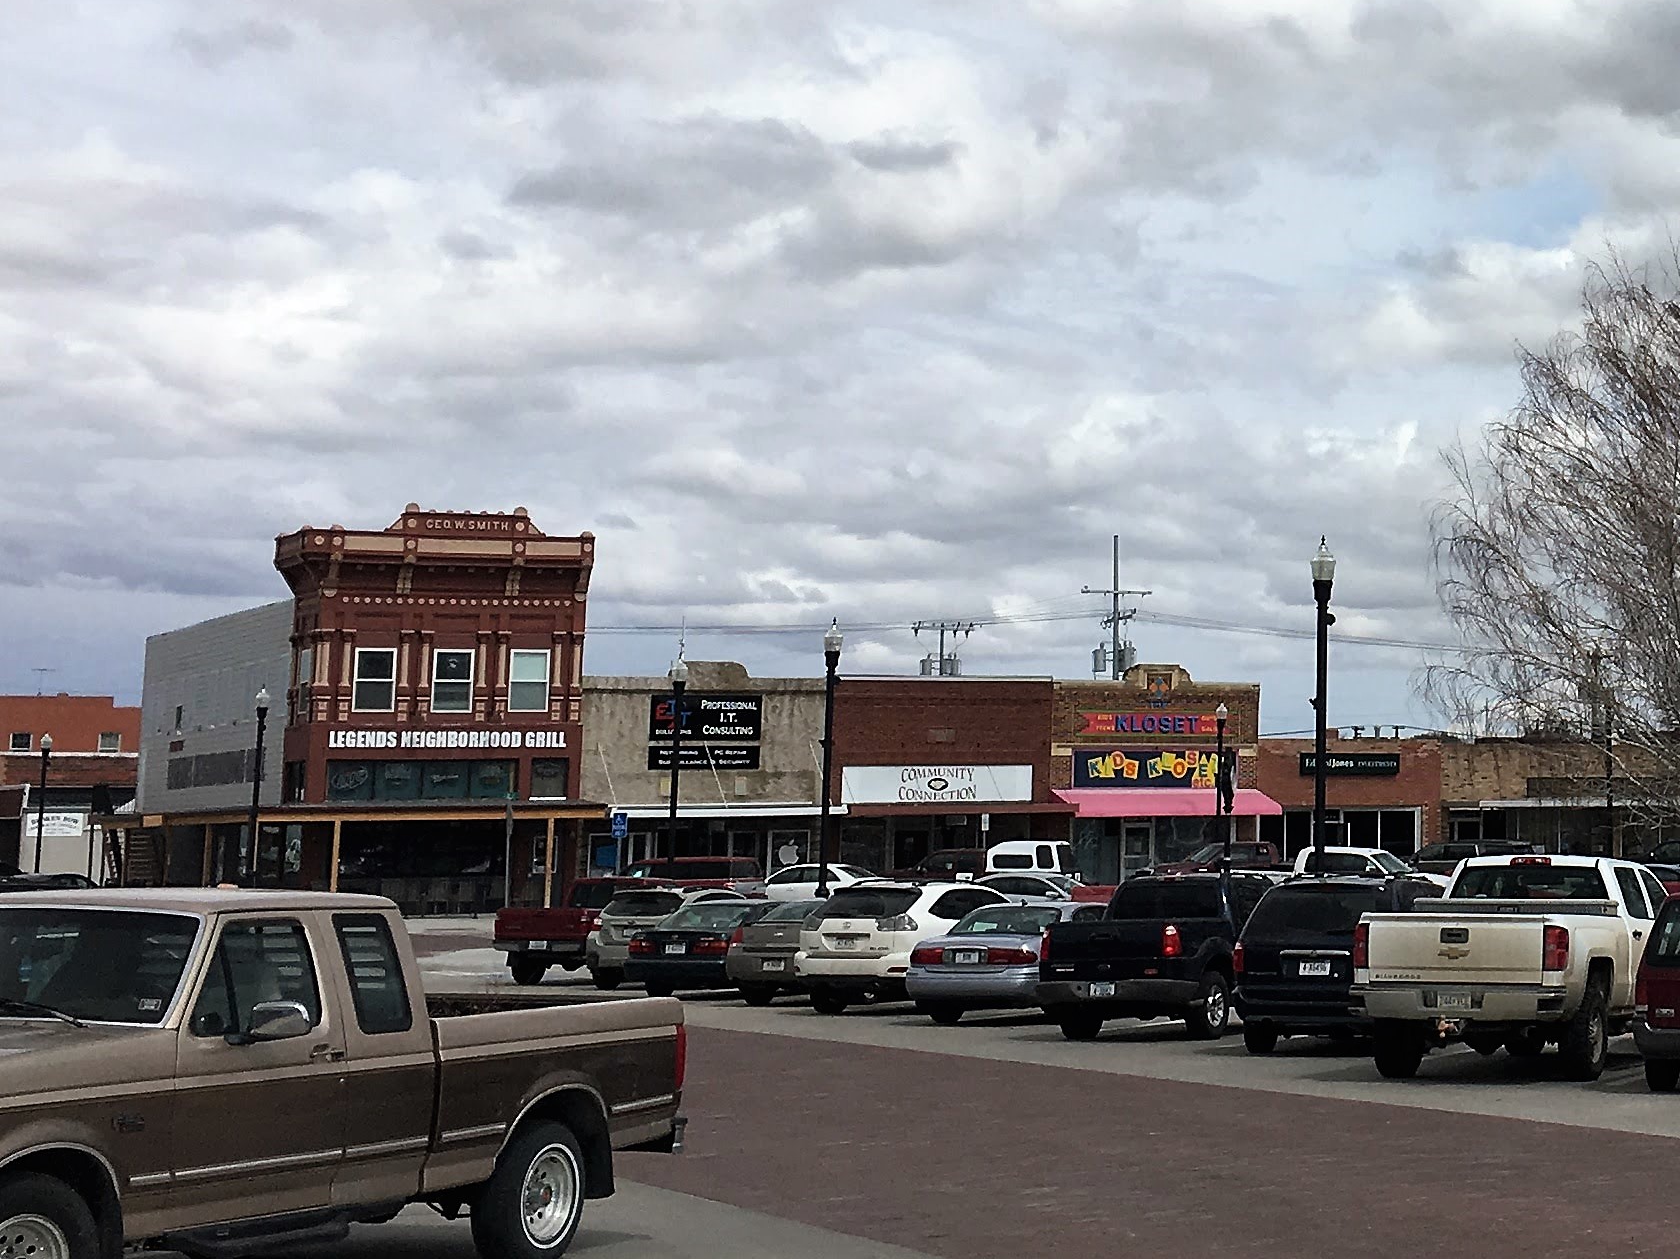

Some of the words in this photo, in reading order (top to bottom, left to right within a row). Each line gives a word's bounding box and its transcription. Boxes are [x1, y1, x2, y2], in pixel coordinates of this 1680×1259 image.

[468, 520, 509, 531] SMITH
[701, 699, 757, 711] PROFESSIONAL
[702, 724, 754, 736] CONSULTING
[1114, 714, 1199, 735] KLOSET
[328, 730, 398, 749] LEGENDS
[400, 730, 523, 749] NEIGHBORHOOD
[525, 731, 567, 748] GRILL
[901, 767, 975, 783] COMMUNITY
[898, 785, 977, 801] CONNECTION
